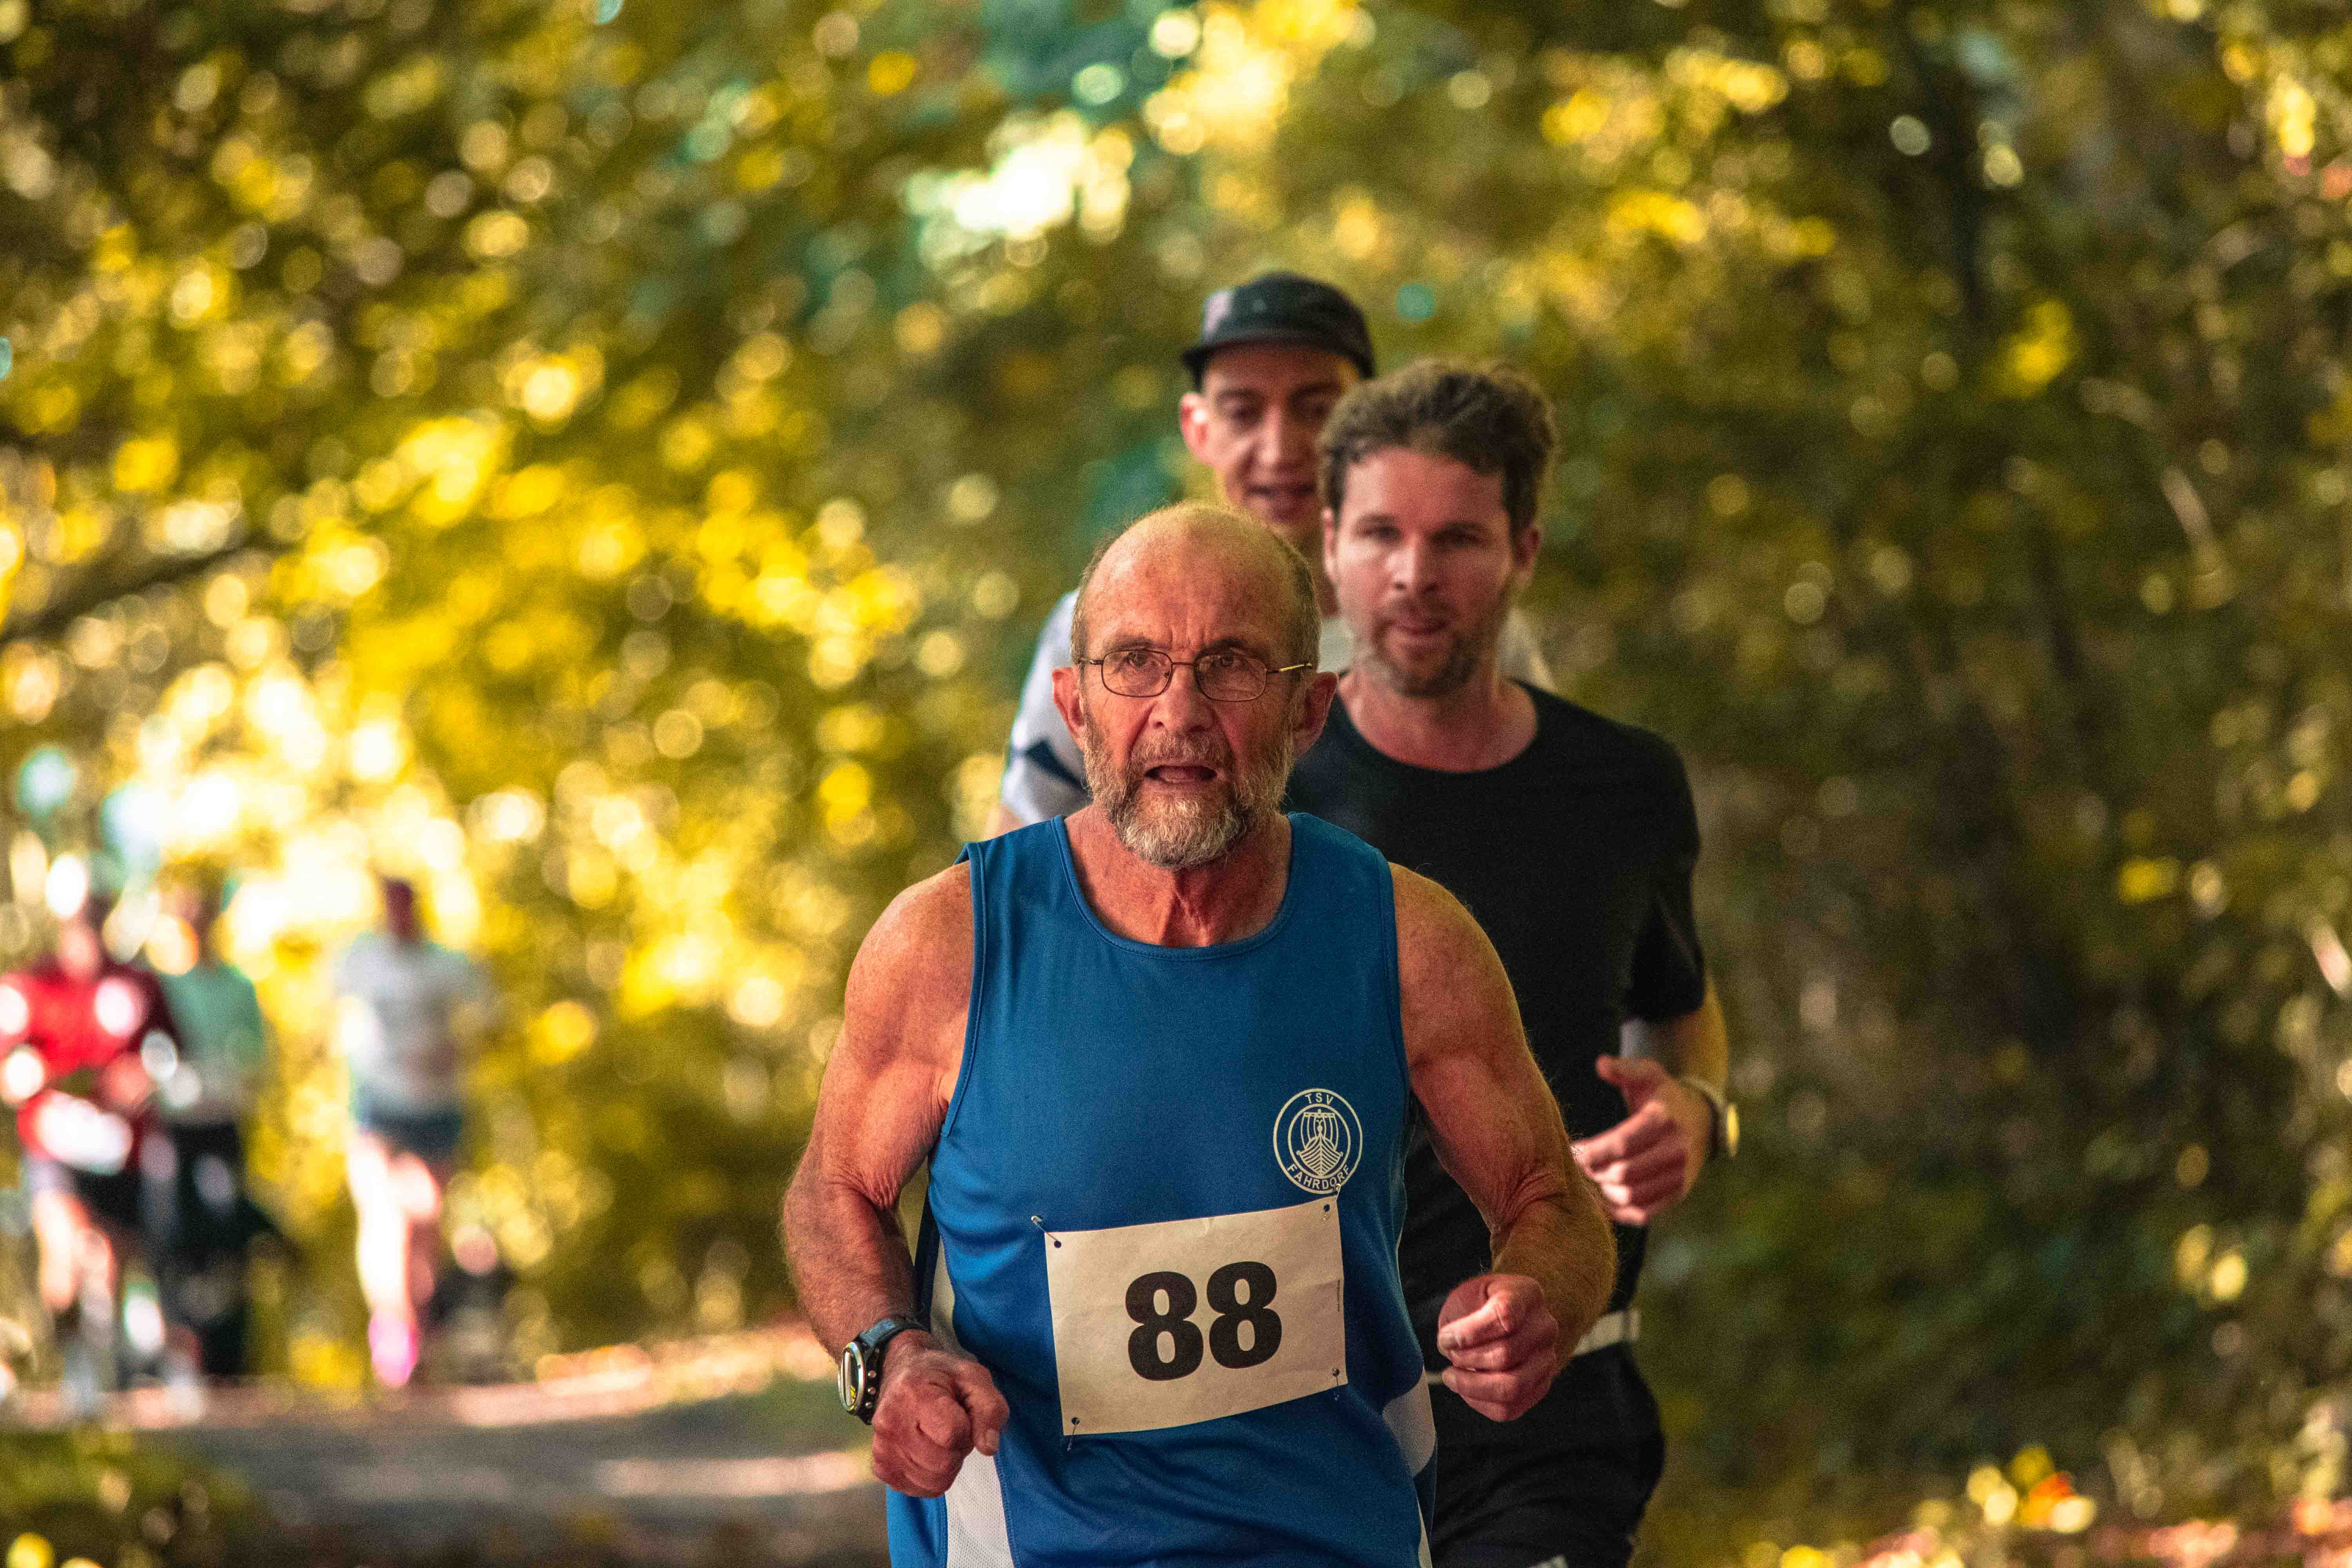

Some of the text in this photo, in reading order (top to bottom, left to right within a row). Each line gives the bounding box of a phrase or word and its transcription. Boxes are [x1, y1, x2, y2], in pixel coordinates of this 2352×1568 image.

[1305, 1093, 1334, 1105] TSV
[1287, 1163, 1349, 1189] FAHRDORF
[1125, 1261, 1282, 1381] 88
